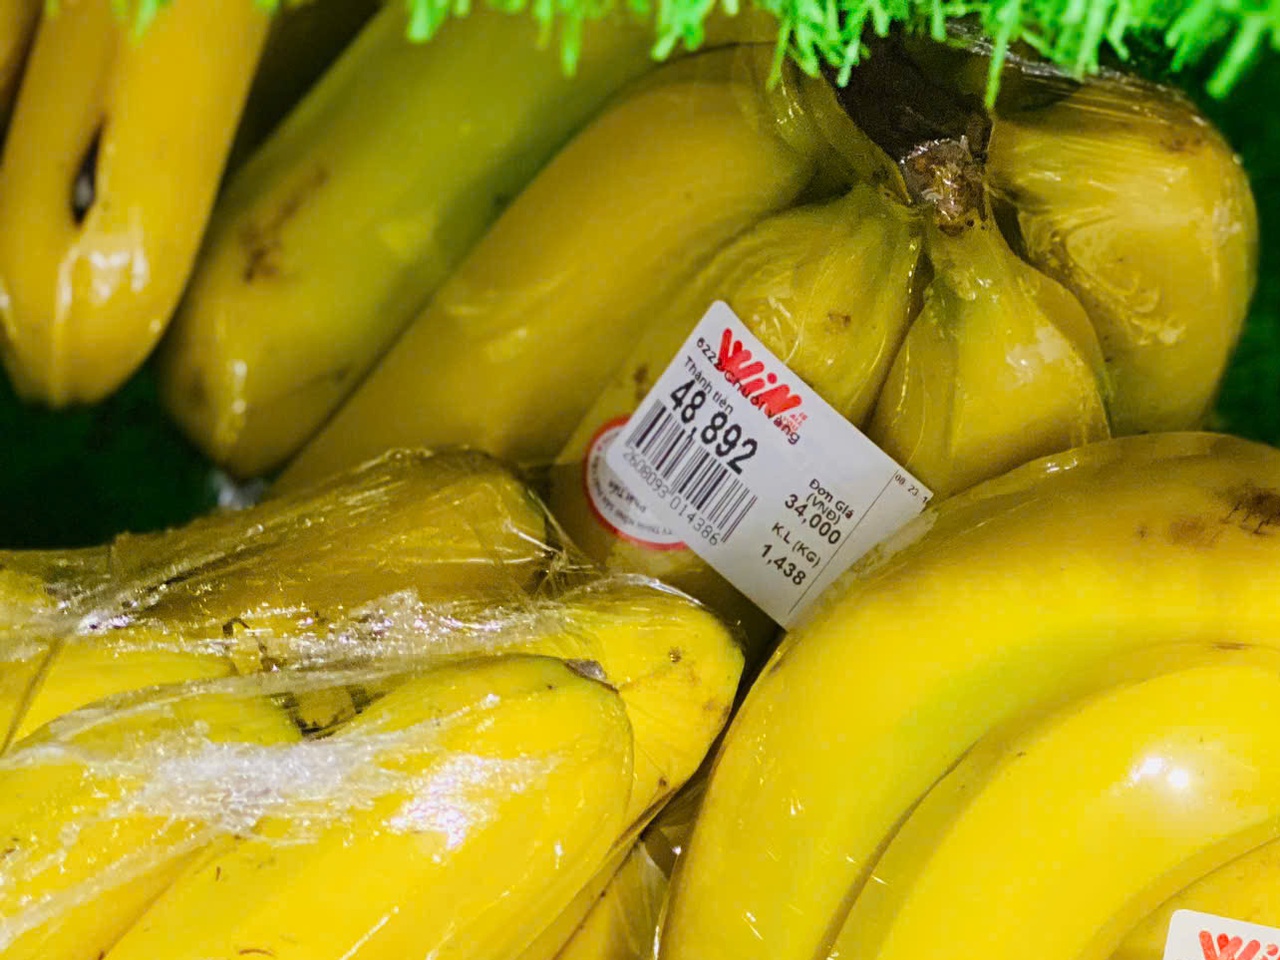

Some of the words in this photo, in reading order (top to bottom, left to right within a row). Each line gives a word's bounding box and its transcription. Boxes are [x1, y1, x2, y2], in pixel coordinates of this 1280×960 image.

[669, 379, 758, 474] 48,892
[806, 493, 841, 525] (VNĐ)
[809, 478, 834, 503] Đơn
[835, 500, 855, 519] Giá
[669, 495, 720, 546] 014386
[784, 494, 842, 545] 34,000
[761, 544, 806, 585] 1,438
[792, 540, 821, 568] (KG)
